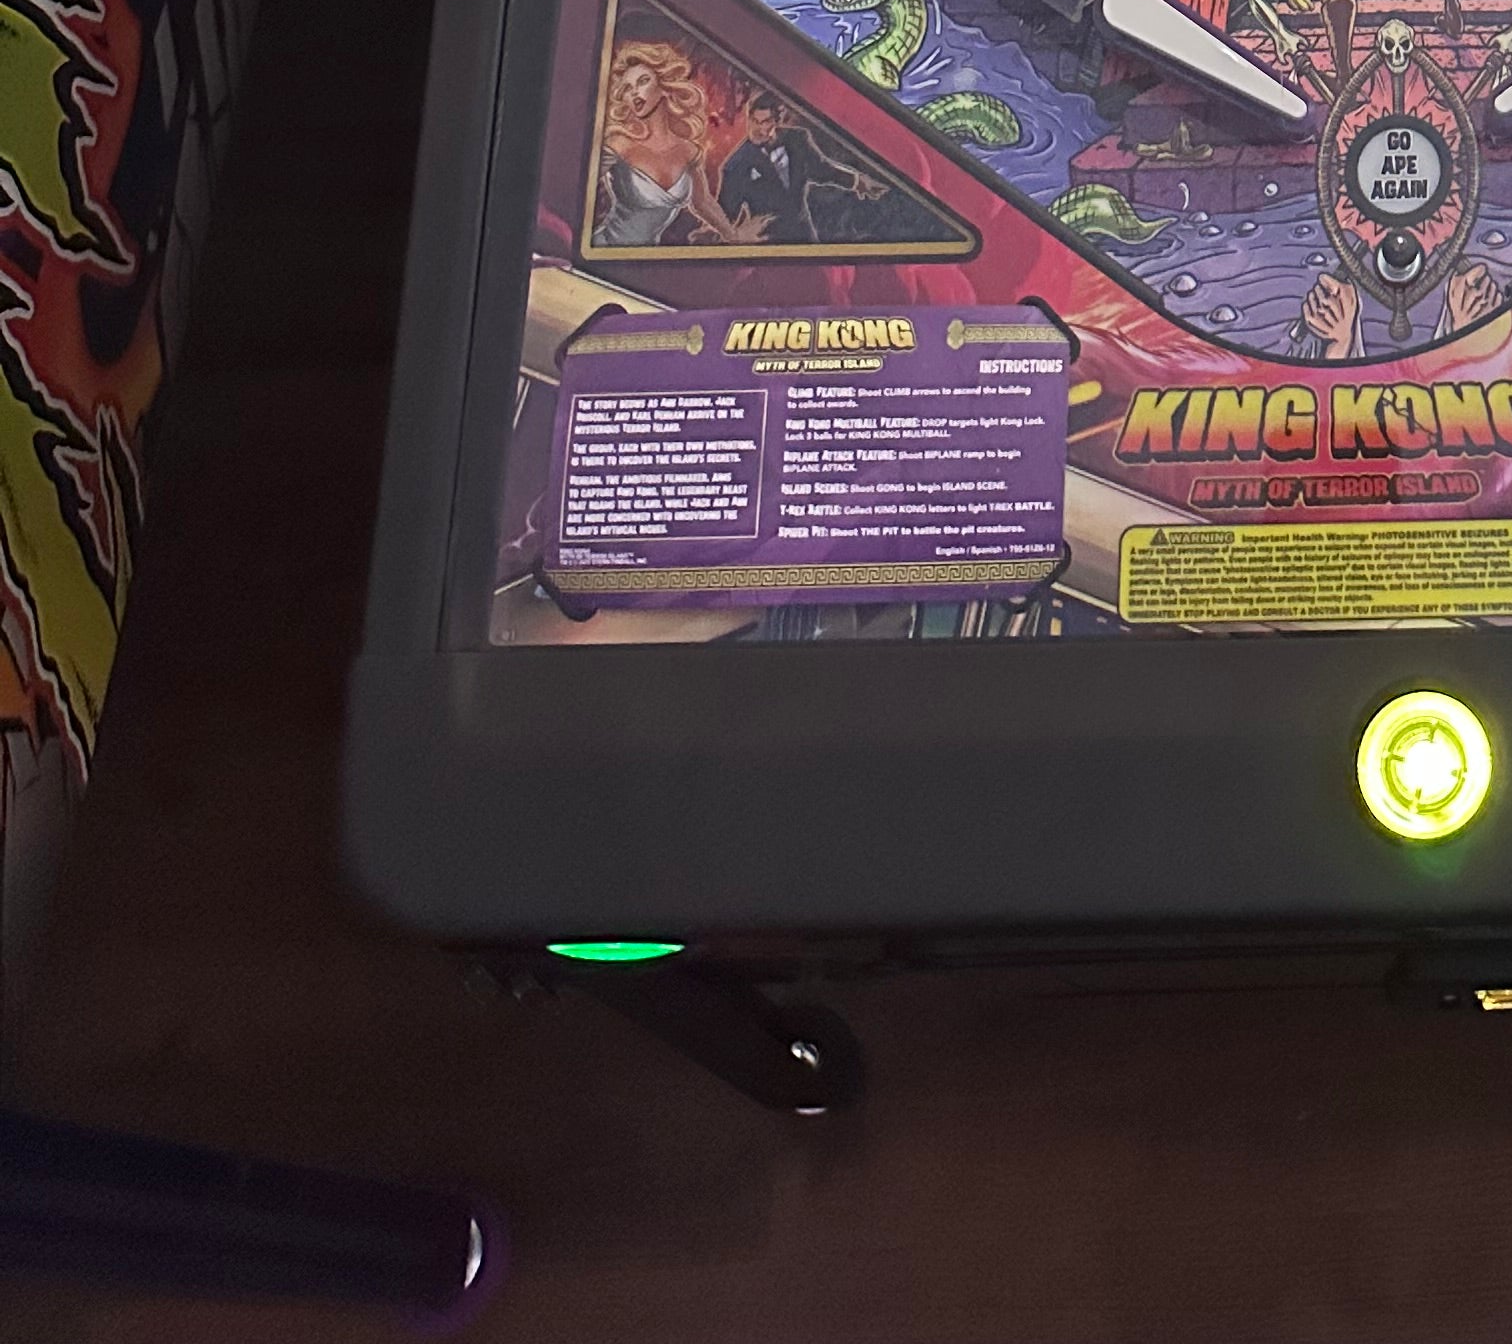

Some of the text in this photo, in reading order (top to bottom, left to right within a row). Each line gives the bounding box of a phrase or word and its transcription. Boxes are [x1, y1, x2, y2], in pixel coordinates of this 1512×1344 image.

[1387, 130, 1412, 152] GO
[1380, 156, 1418, 176] APE
[1370, 179, 1428, 201] AGAIN
[724, 319, 915, 354] KING KONG
[756, 359, 881, 372] MYTH OF TERROR ISLAND
[979, 359, 1063, 374] INSTRUCTIONS
[1117, 385, 1318, 463] KING
[1193, 473, 1476, 502] MYTH OF TERROR ISLAND
[874, 505, 897, 514] KING
[899, 504, 927, 513] KONG
[928, 504, 955, 513] letters
[968, 503, 987, 514] light
[1015, 502, 1055, 511] BATTLE.
[1170, 529, 1509, 544] WARNING Important Health Warning: PHOTOSENSITIVE SEIZURES
